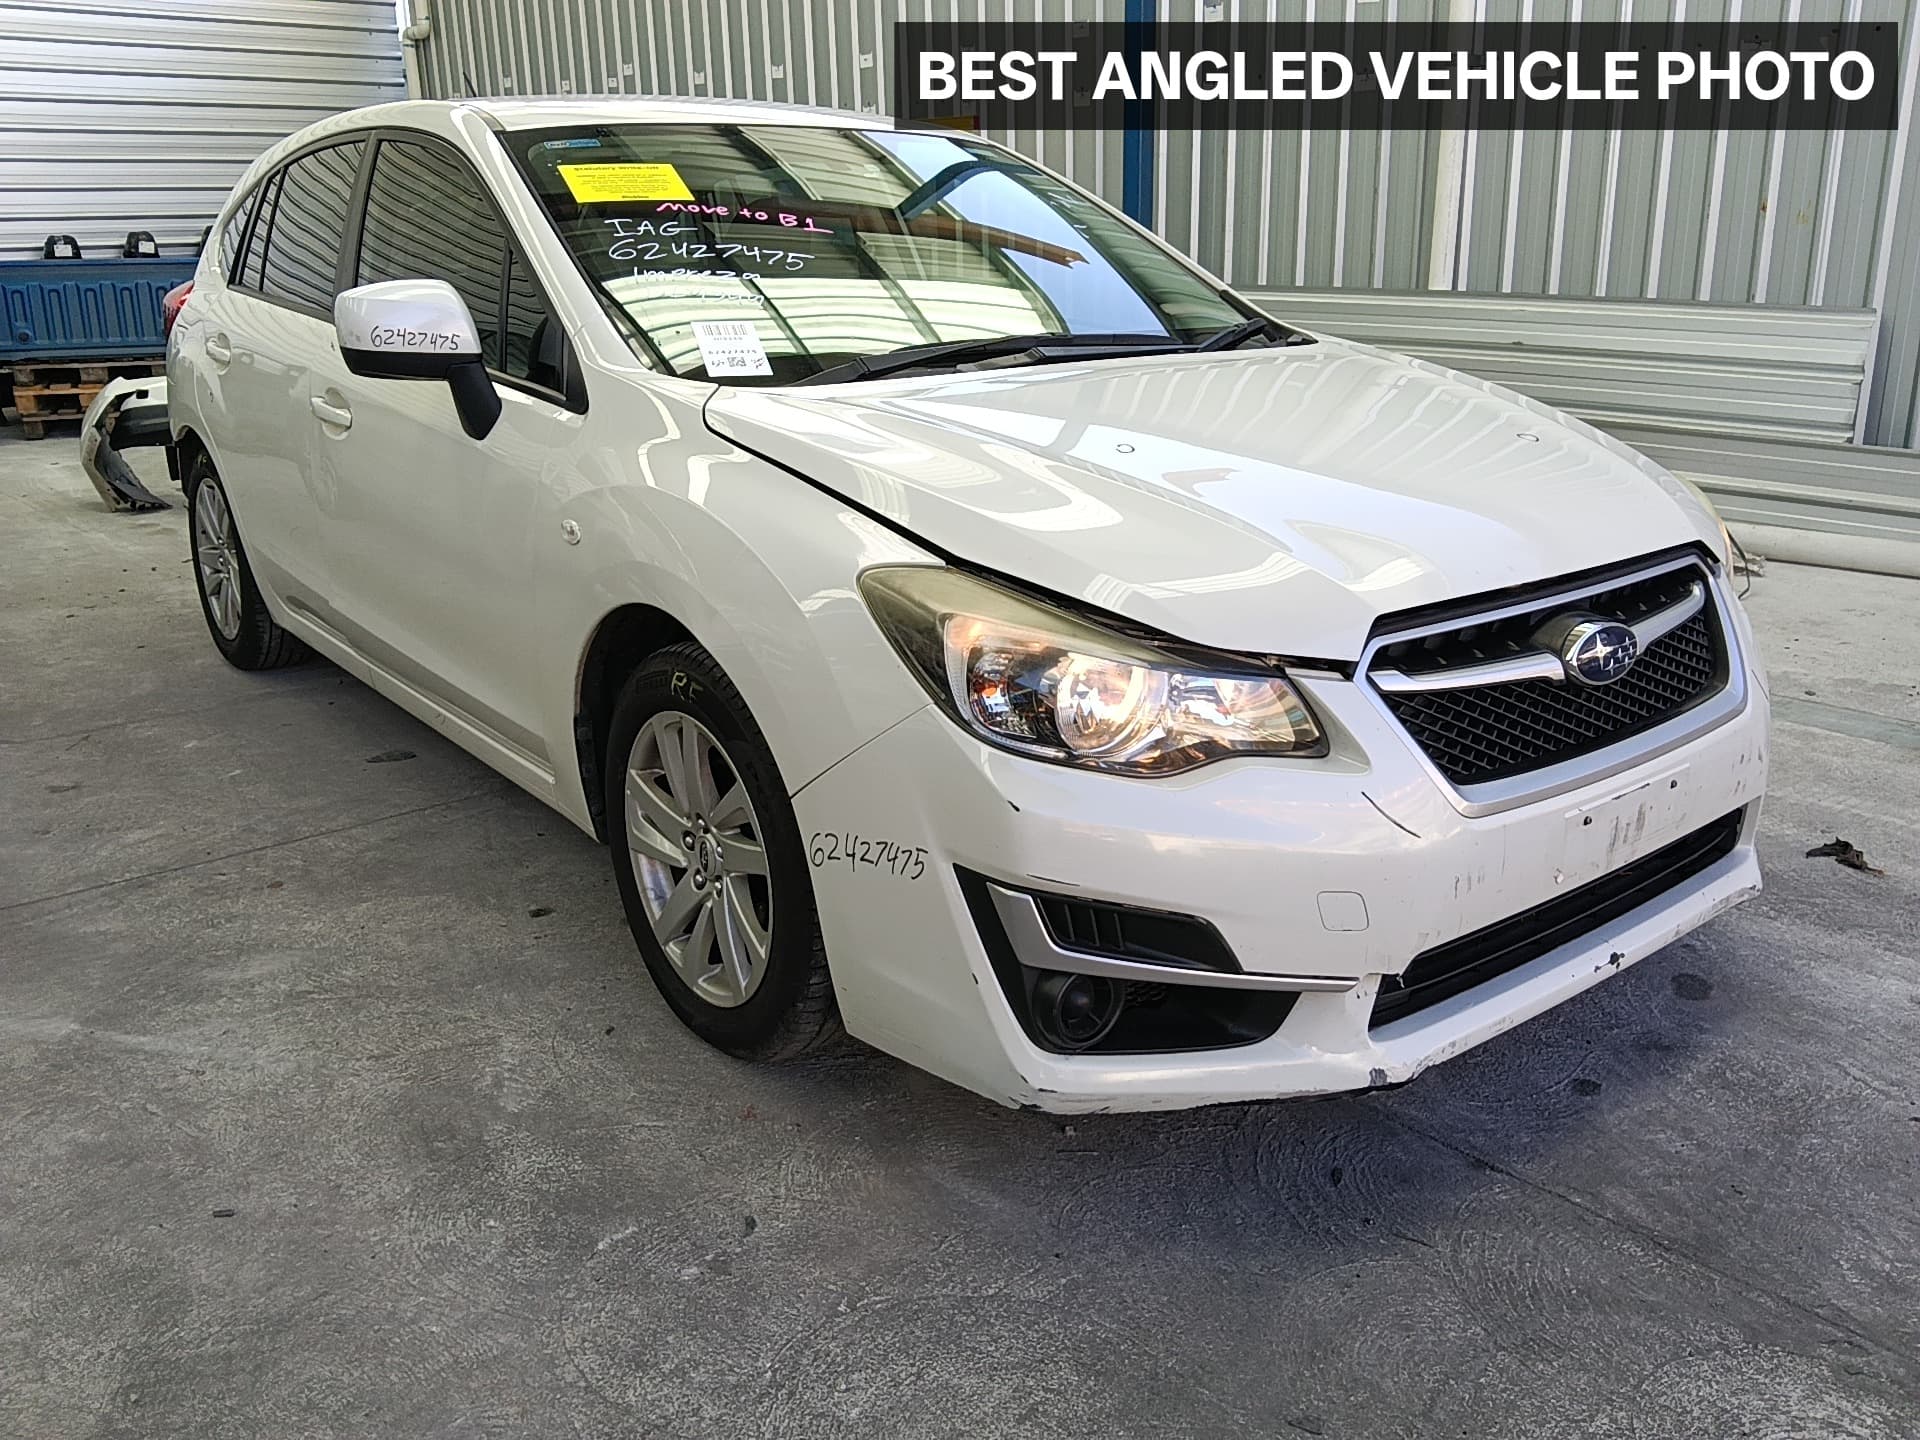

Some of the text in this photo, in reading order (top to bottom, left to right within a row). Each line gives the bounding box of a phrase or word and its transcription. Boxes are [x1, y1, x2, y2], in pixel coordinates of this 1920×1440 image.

[603, 218, 699, 237] IAG
[739, 208, 769, 221] to
[778, 213, 834, 235] B1
[608, 239, 816, 271] 62427475
[370, 325, 461, 351] 62427475
[809, 832, 929, 880] 62427475
